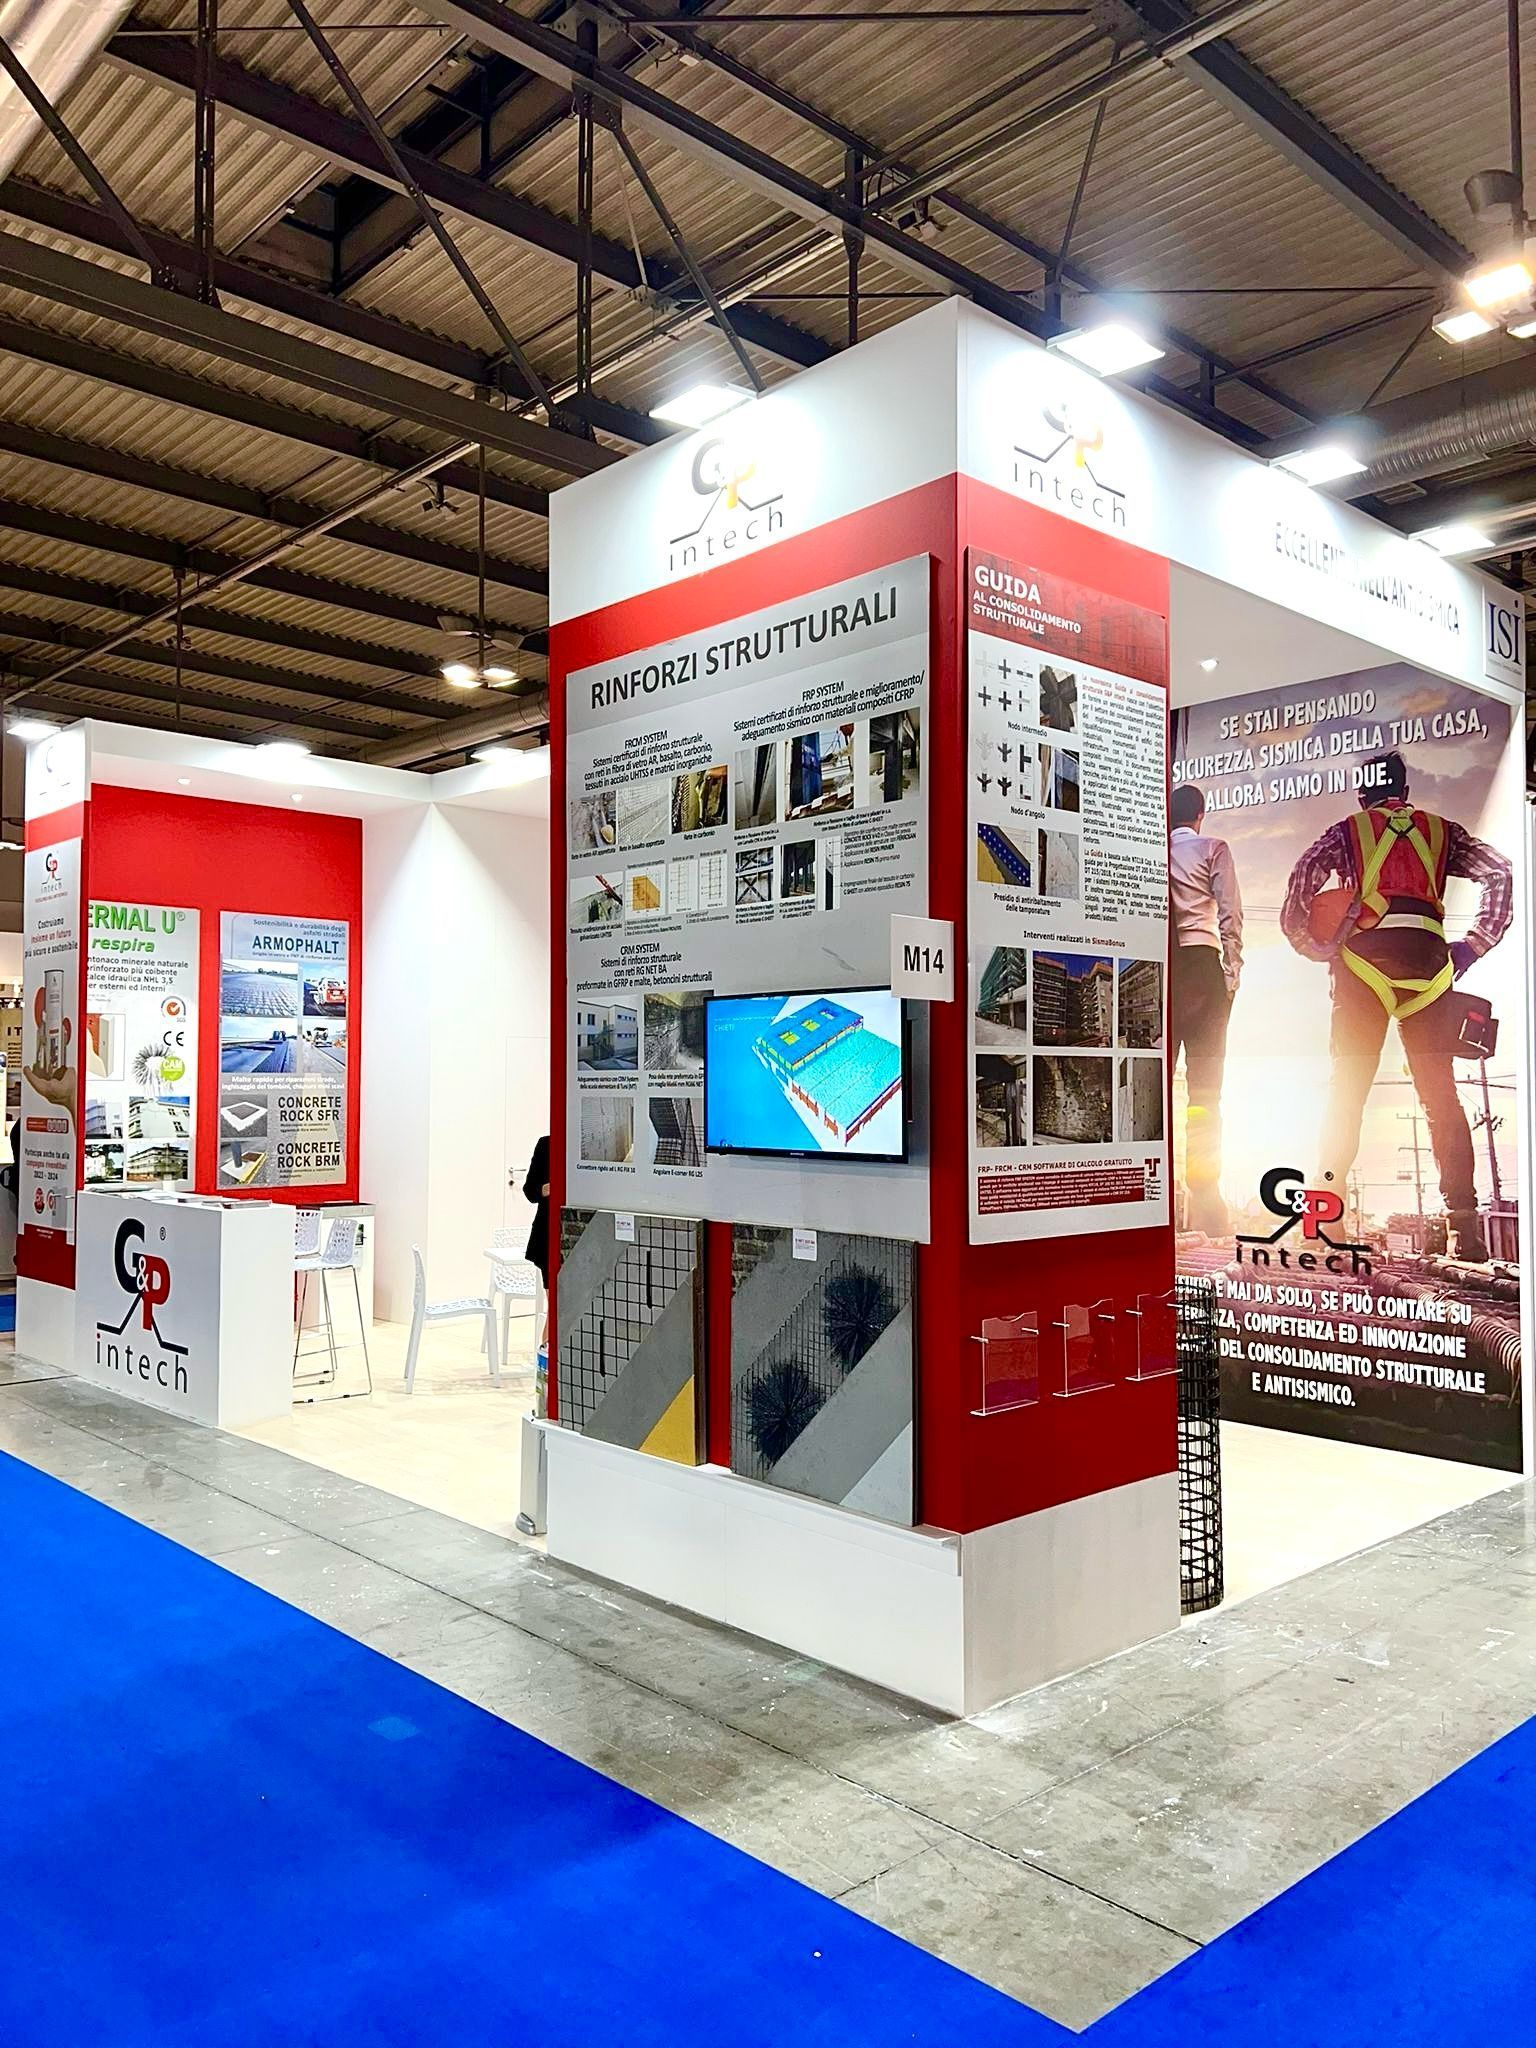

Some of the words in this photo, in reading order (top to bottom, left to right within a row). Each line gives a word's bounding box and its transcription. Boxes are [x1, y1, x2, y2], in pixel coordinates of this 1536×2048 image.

[1014, 463, 1126, 526] intech
[669, 507, 783, 570] intech
[974, 565, 1042, 604] GUIDA
[973, 590, 987, 601] AL
[989, 593, 1081, 633] CONSOLIDAMENTO
[973, 604, 1045, 635] STRUTTURALE
[591, 652, 697, 709] RINFORZI
[705, 586, 897, 676] STRUTTURALI
[803, 687, 815, 701] FRP
[816, 681, 844, 698] SYSTEM
[734, 717, 756, 732] Sistemi
[757, 708, 787, 725] certificati
[796, 700, 820, 716] rinforzo
[822, 691, 858, 709] strutturale
[742, 724, 785, 742] adeguamento
[787, 716, 810, 730] sismico
[812, 713, 824, 723] con
[825, 703, 856, 719] materiali
[858, 694, 893, 712] compositi
[894, 688, 915, 703] CFRP
[1219, 715, 1240, 740] SE
[1244, 709, 1278, 735] STAI
[1284, 689, 1376, 728] PENSANDO
[624, 736, 642, 749] FRCM
[644, 730, 667, 746] SYSTEM
[1008, 721, 1021, 731] Nodo
[1022, 725, 1047, 737] intermedio
[593, 755, 613, 768] Sistemi
[613, 748, 639, 763] certificati
[647, 742, 669, 755] rinforzo
[671, 732, 703, 749] strutturale
[1172, 747, 1255, 783] SICUREZZA
[1259, 738, 1325, 769] SISMICA
[1330, 730, 1384, 757] DELLA
[1389, 719, 1426, 746] TUA
[1431, 708, 1488, 740] CASA,
[584, 772, 594, 780] con
[596, 767, 605, 778] reti
[612, 763, 624, 774] fibra
[632, 759, 647, 769] vetro
[660, 749, 683, 762] basalto,
[610, 772, 629, 785] acciaio
[630, 767, 649, 781] UHTSS
[676, 754, 712, 770] inorganiche
[1204, 782, 1265, 813] ALLORA
[1270, 774, 1322, 803] SIAMO
[1328, 772, 1345, 794] IN
[1352, 762, 1393, 791] DUE.
[1011, 806, 1024, 816] Nodo
[1025, 808, 1046, 820] d'angolo
[994, 893, 1014, 903] Presidio
[1006, 904, 1017, 912] delle
[1018, 905, 1050, 916] tamponature
[254, 919, 293, 927] Sostenibilità
[301, 922, 330, 930] durabilità
[331, 923, 346, 932] degli
[92, 938, 155, 953] respira
[252, 936, 339, 954] ARMOPHALT
[620, 946, 635, 955] CRM
[636, 943, 660, 953] SYSTEM
[1024, 931, 1055, 941] Interventi
[1056, 935, 1084, 944] realizzati
[1092, 938, 1125, 948] SismaBonus
[122, 958, 155, 966] minerale
[157, 960, 188, 968] naturale
[601, 957, 621, 968] Sistemi
[628, 955, 650, 966] rinforzo
[651, 952, 682, 964] strutturale
[904, 945, 944, 974] M14
[131, 966, 142, 974] più
[145, 968, 177, 976] coibente
[162, 977, 173, 985] 3,5
[614, 969, 625, 977] con
[626, 967, 635, 976] reti
[636, 966, 645, 975] RG
[646, 965, 657, 974] NET
[659, 964, 667, 973] BA
[141, 984, 166, 992] interni
[577, 980, 606, 992] preformate
[614, 978, 628, 988] GFRP
[653, 973, 681, 985] betoncini
[682, 971, 712, 983] strutturali
[163, 1031, 184, 1046] CE
[278, 1097, 341, 1108] CONCRETE
[280, 1110, 313, 1121] ROCK
[318, 1109, 340, 1121] SFR
[277, 1142, 341, 1155] CONCRETE
[278, 1156, 311, 1168] ROCK
[316, 1155, 340, 1166] BRM
[1034, 1162, 1066, 1170] SOFTWARE
[1077, 1160, 1103, 1168] CALCOLO
[1259, 1167, 1344, 1239] G&P
[1235, 1242, 1374, 1277] intech
[114, 1218, 171, 1331] G&P
[1227, 1279, 1251, 1302] MAI
[1255, 1283, 1273, 1306] DA
[1277, 1287, 1317, 1313] SOLO,
[1321, 1290, 1339, 1312] SE
[1342, 1291, 1372, 1318] PUÒ
[1377, 1296, 1446, 1324] CONTARE
[1452, 1304, 1472, 1326] SU
[1244, 1312, 1335, 1343] COMPETENZA
[1339, 1322, 1358, 1344] ED
[1362, 1325, 1466, 1358] INNOVAZIONE
[97, 1333, 188, 1394] intech
[1220, 1338, 1245, 1360] DEL
[1248, 1341, 1372, 1378] CONSOLIDAMENTO
[1376, 1359, 1486, 1394] STRUTTURALE
[1252, 1372, 1261, 1392] E
[1264, 1374, 1356, 1407] ANTISISMICO.
